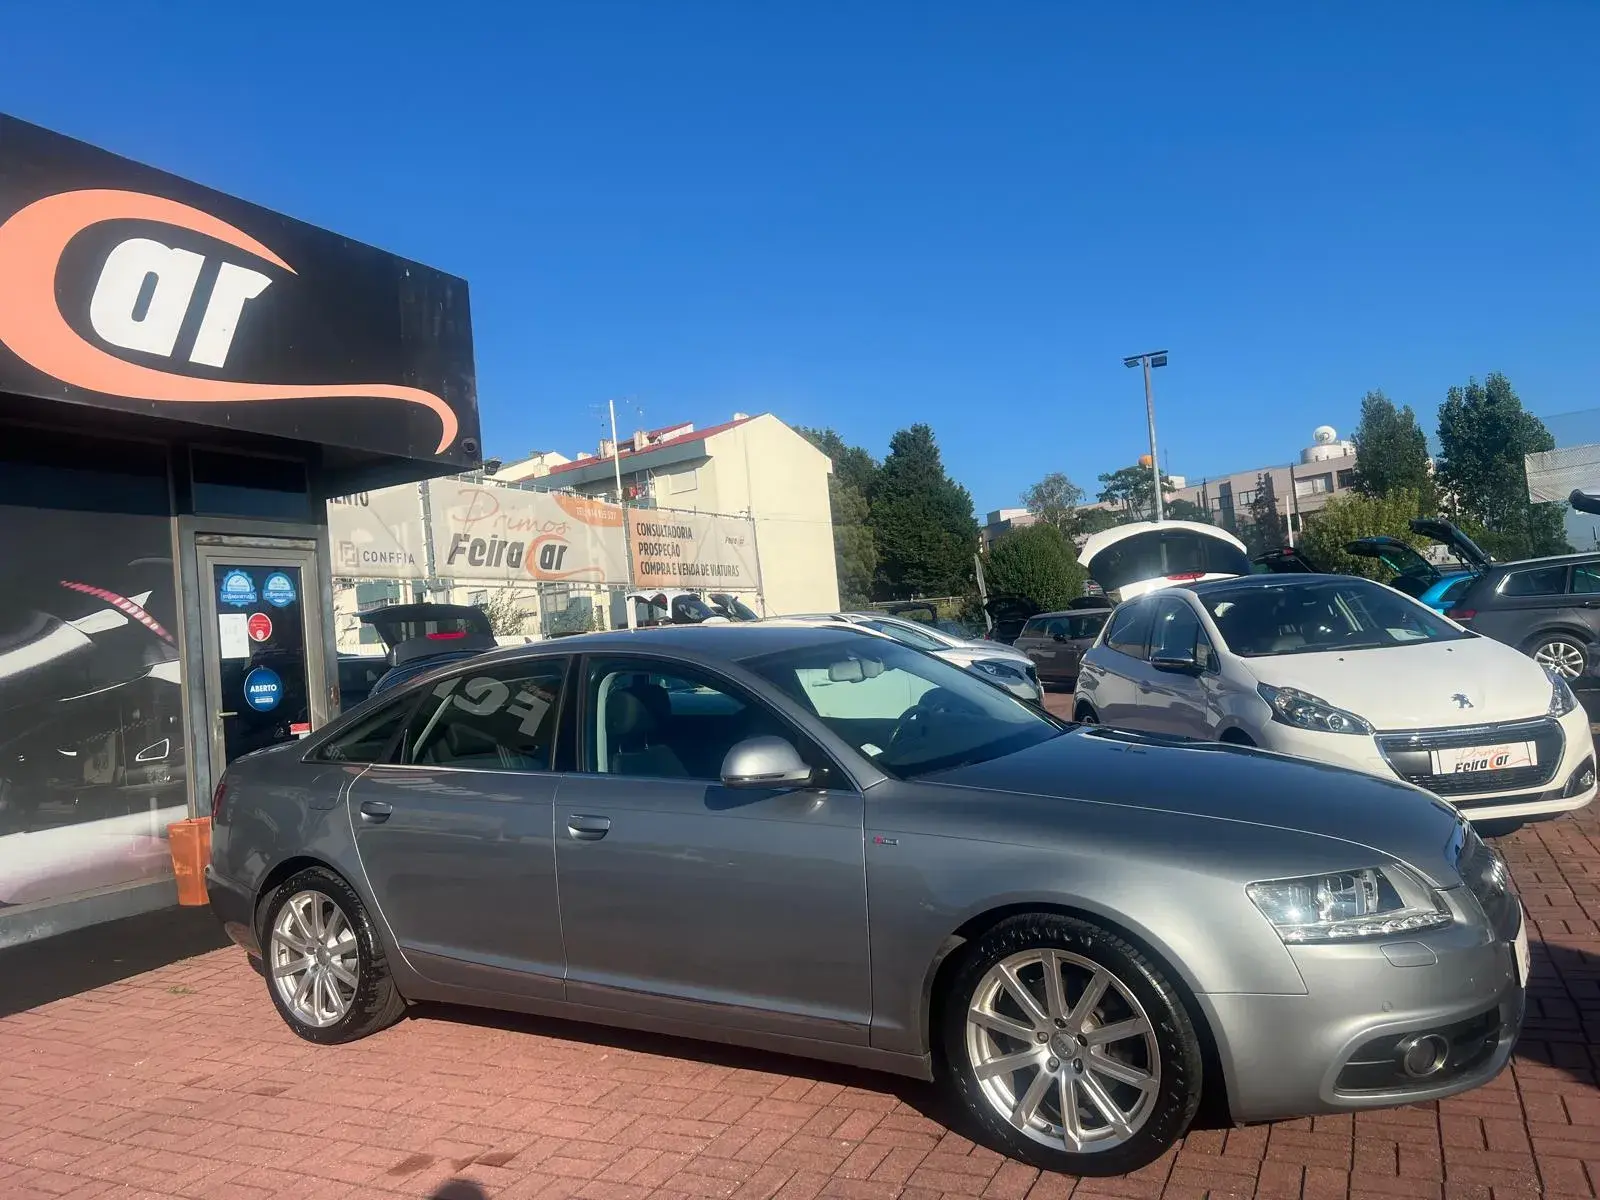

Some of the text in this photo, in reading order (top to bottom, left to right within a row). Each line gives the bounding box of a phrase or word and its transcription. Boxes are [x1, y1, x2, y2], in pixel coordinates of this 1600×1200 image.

[452, 489, 572, 534] Primos
[636, 522, 693, 540] CONSULTADORIA
[638, 541, 681, 559] PROSPEÇÃO
[641, 561, 740, 577] COMPRA E VENDA DE VIATURAS
[249, 684, 278, 693] ABERTO
